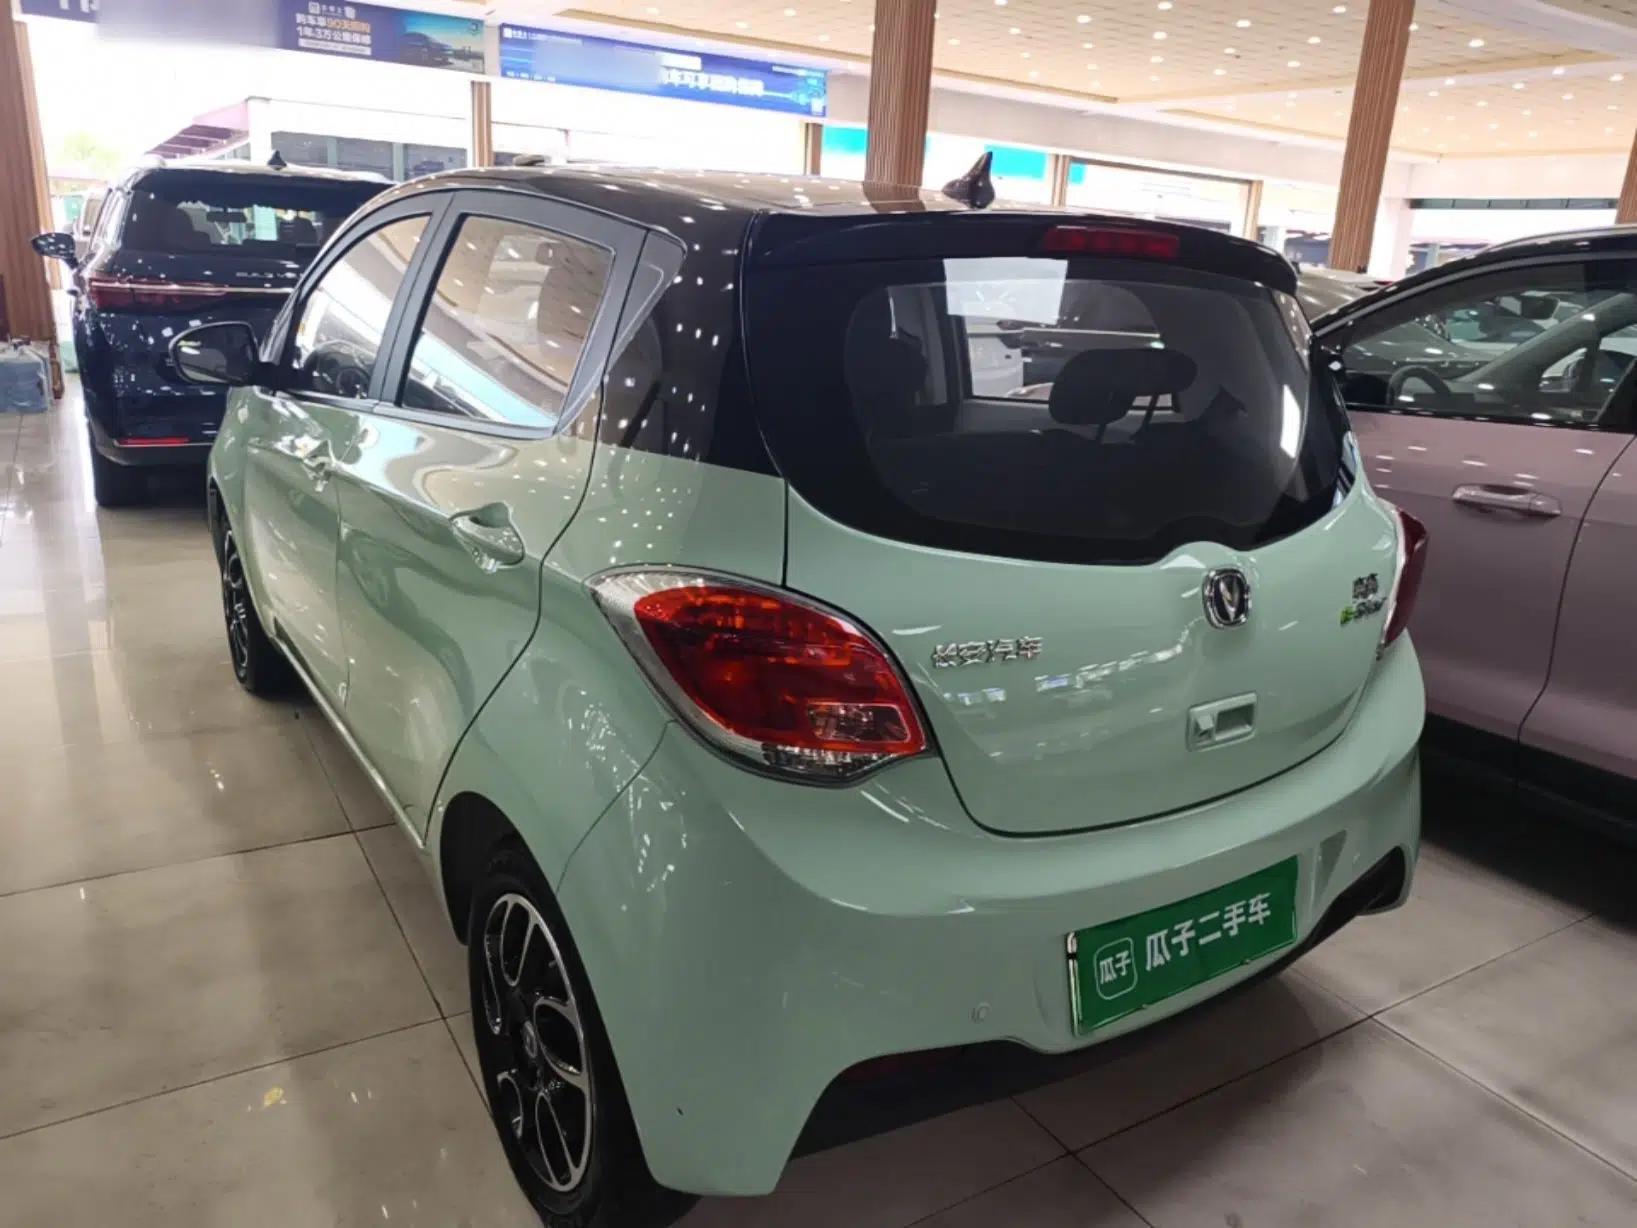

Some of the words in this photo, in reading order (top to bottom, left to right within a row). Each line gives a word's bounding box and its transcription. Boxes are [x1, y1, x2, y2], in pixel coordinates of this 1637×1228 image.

[932, 636, 1042, 667] 长安汽车
[1145, 892, 1271, 971] 瓜子二手车
[1099, 950, 1131, 984] 瓜子
